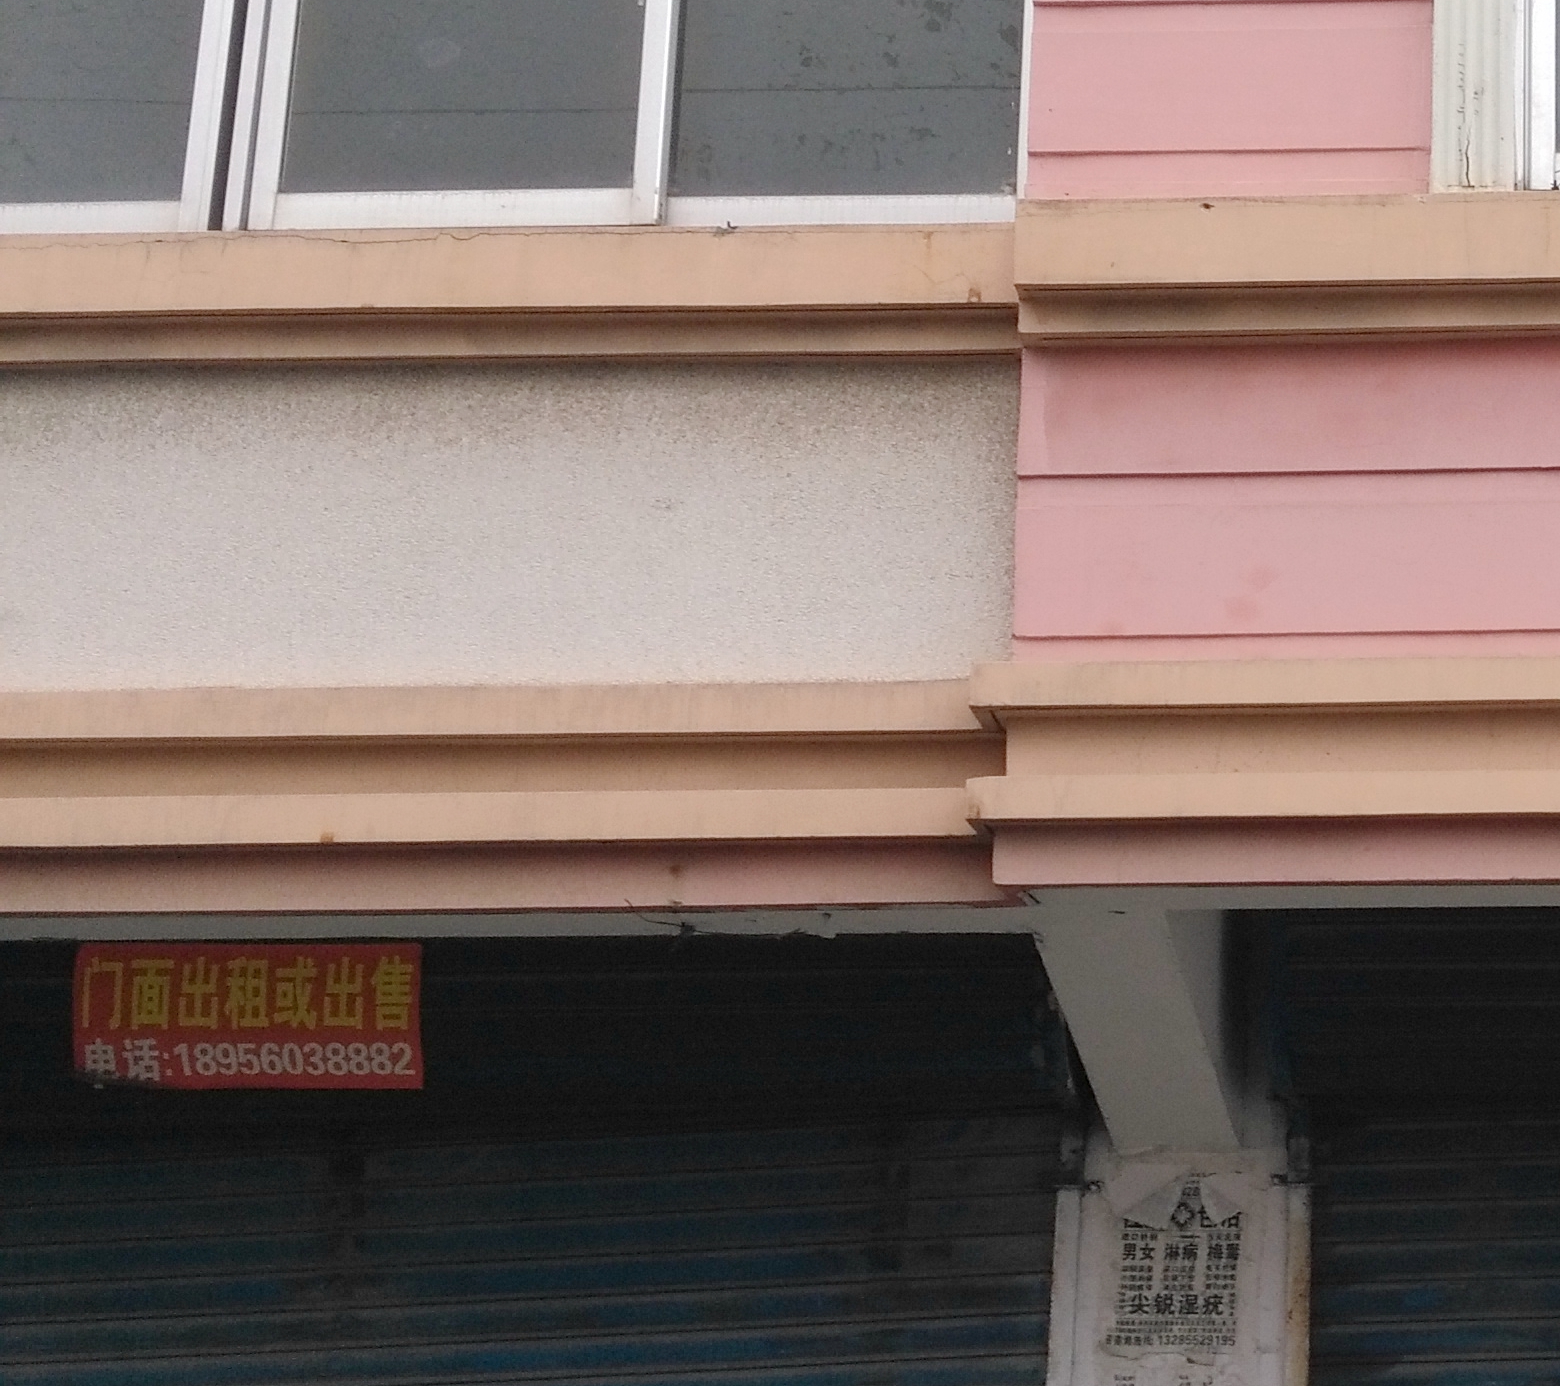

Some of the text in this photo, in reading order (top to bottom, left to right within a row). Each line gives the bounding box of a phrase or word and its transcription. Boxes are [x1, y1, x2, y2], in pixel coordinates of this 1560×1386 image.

[81, 955, 413, 1030] 门面出租或出售
[1122, 1243, 1155, 1261] 男女
[1128, 1293, 1224, 1315] 尖锐湿疣
